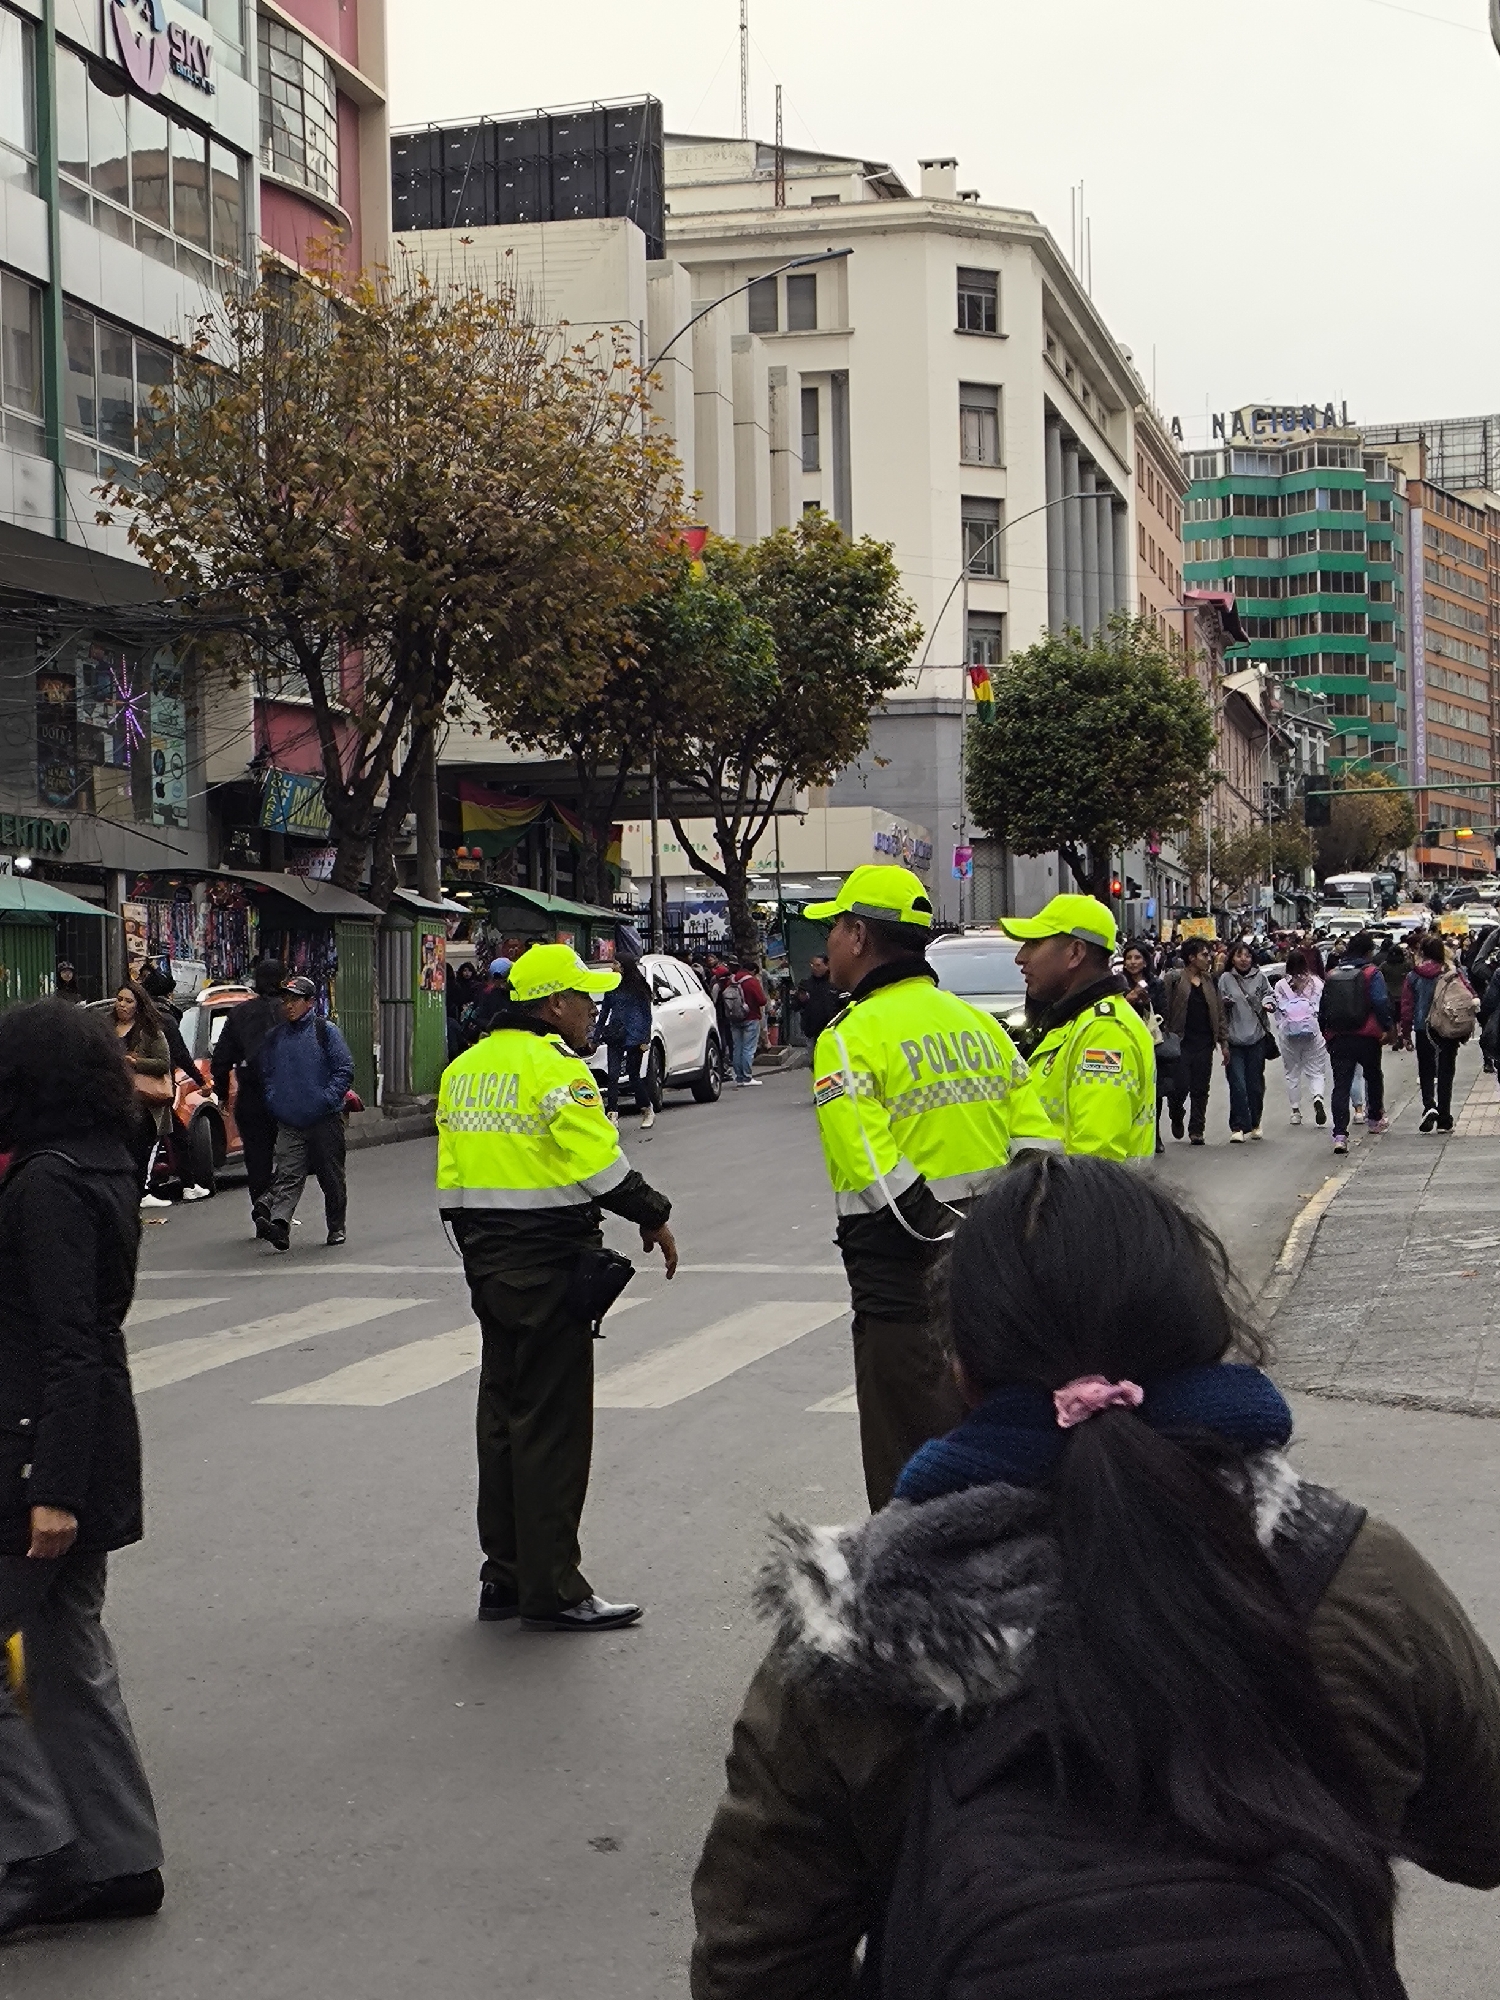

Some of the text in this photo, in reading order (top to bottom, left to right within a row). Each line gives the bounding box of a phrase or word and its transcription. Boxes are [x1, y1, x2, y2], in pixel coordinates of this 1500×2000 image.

[167, 21, 214, 78] SKY
[1212, 400, 1356, 440] NACIONAL
[1414, 582, 1424, 689] PATRIMONIO
[902, 1030, 1006, 1081] POLICIA
[450, 1073, 520, 1110] POLICIA
